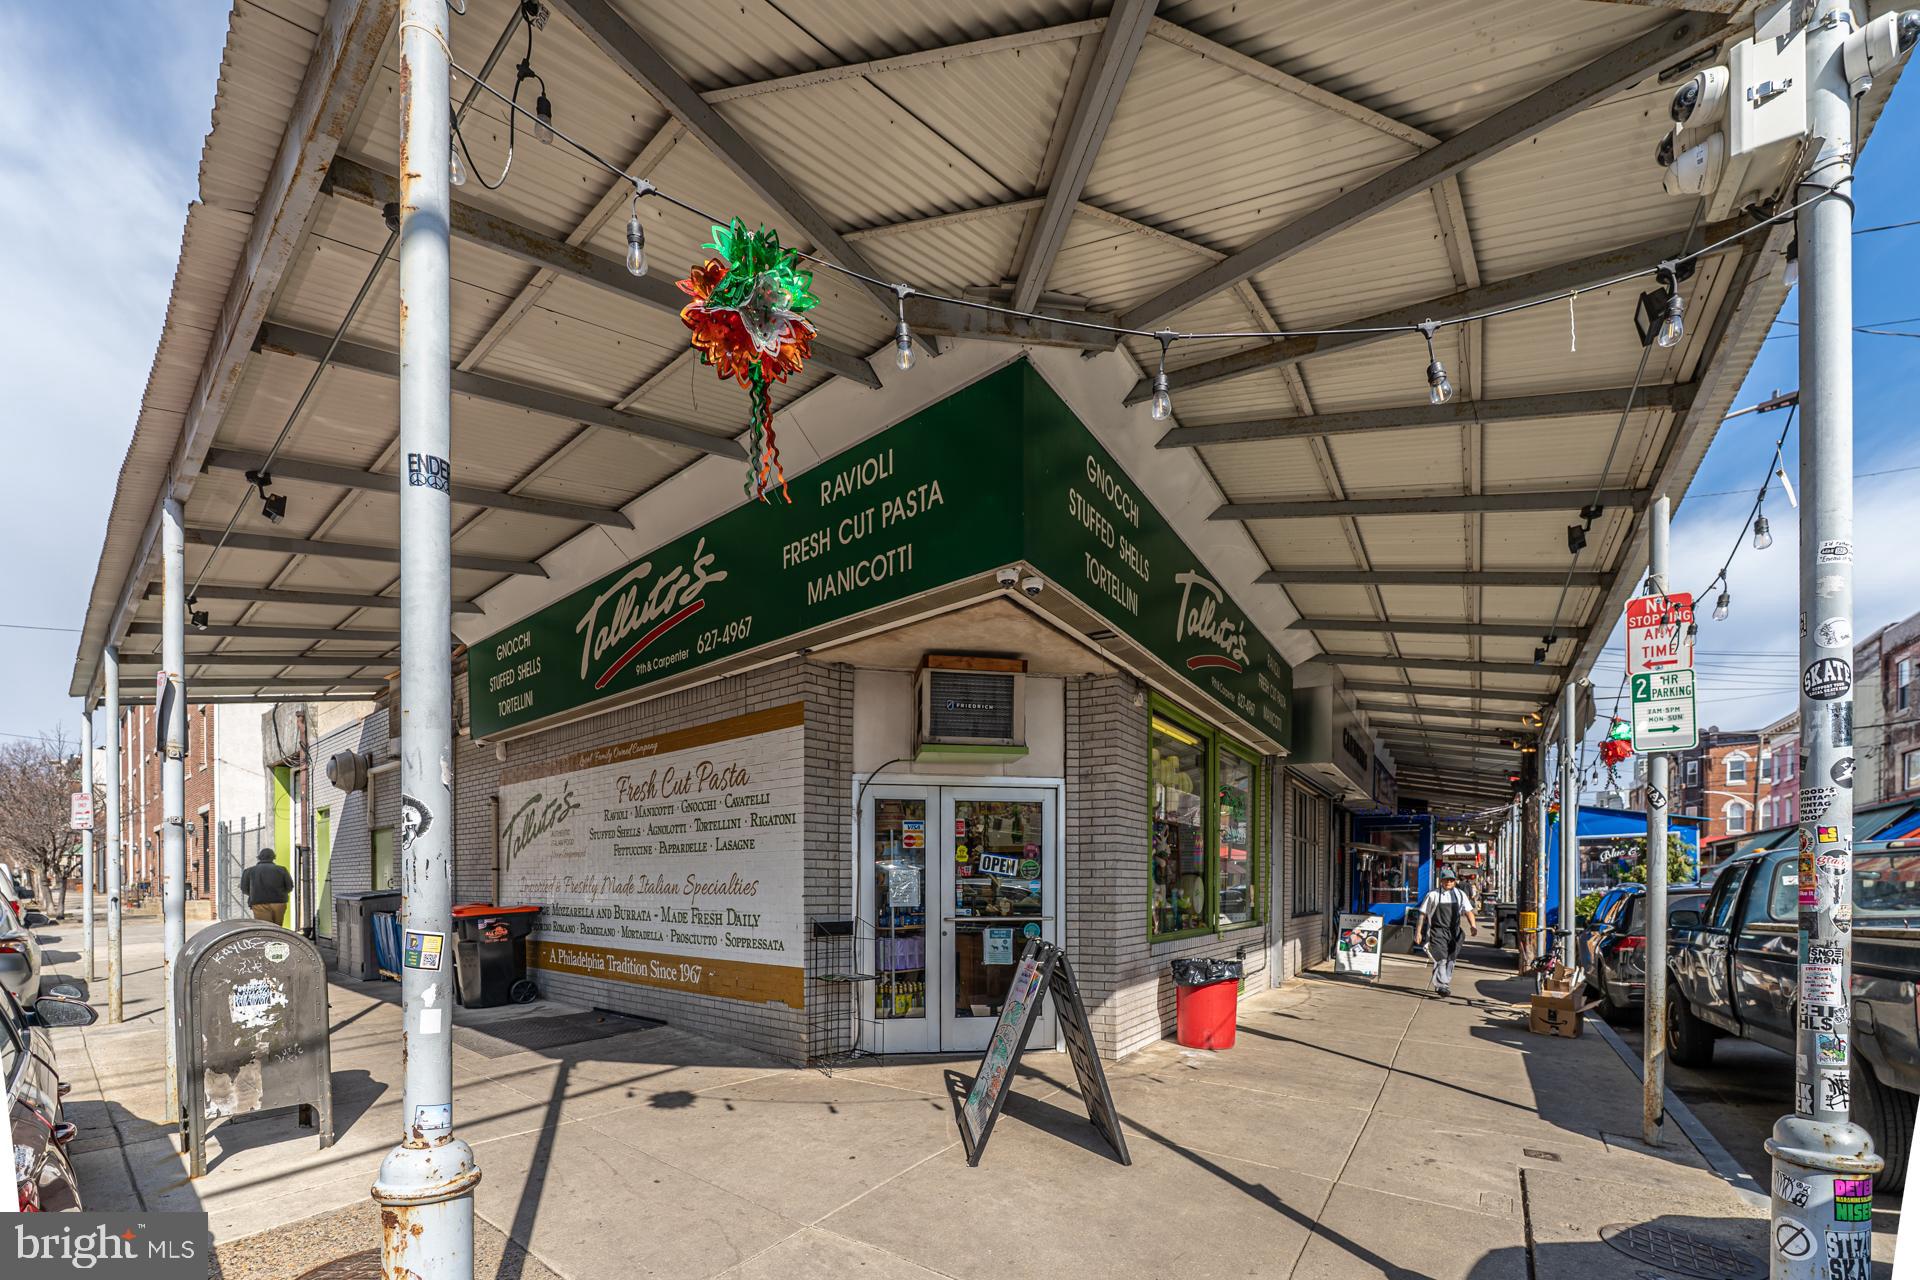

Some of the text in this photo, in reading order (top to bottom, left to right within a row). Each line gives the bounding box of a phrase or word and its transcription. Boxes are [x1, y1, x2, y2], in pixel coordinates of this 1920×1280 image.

[821, 448, 893, 506] RAVIOLI
[1086, 455, 1139, 528] GNOCCHI
[783, 480, 944, 569] FRESH CUT PASTA
[1069, 488, 1149, 582] STUFFED SHELLS
[807, 544, 913, 605] MANICOTTI
[1085, 552, 1138, 617] TORTELLINI
[576, 537, 728, 679] Talluto's
[1175, 569, 1250, 666] Talluto's
[1629, 610, 1692, 628] STOPING
[496, 631, 531, 661] GNOCCHI
[696, 615, 753, 654] 627-4967
[1644, 626, 1676, 641] ANY
[653, 649, 689, 670] Carpenter
[1642, 644, 1678, 659] TIME
[490, 657, 541, 692] STUFFED SHELLS
[1636, 674, 1679, 699] 2 HR
[1804, 660, 1851, 691] SKATE
[498, 690, 534, 717] TORTELLINI
[956, 702, 994, 710] FRIEDRICH
[1651, 685, 1692, 699] PARKING
[616, 760, 751, 804] Fresh Cut Pasta
[604, 793, 770, 822] RAVIOLI MANICOTTI GNOCCHI CAVATELLI
[589, 812, 796, 840] STUFFED SHELLS AGNOLOTTI TORTELLINI RIGATONI
[613, 837, 755, 857] FETTUCCINE PAPPARDELLE LASAGNE
[982, 856, 1016, 875] OPEN
[564, 875, 598, 903] Freshly
[600, 873, 635, 897] Made
[637, 873, 680, 895] Italian
[683, 872, 759, 905] Specialties
[551, 902, 594, 919] MOZZARELLA
[596, 908, 612, 920] AND
[613, 904, 652, 922] BURRATA
[661, 906, 688, 924] MADE
[691, 907, 723, 926] FRESH
[726, 908, 760, 927] DAILY
[621, 926, 664, 942] MORTADELLA
[670, 929, 717, 946] PROSCIUTTO
[725, 932, 785, 951] SOPPRESSATA
[550, 948, 703, 984] A Philadelphia Tradition Since 1967
